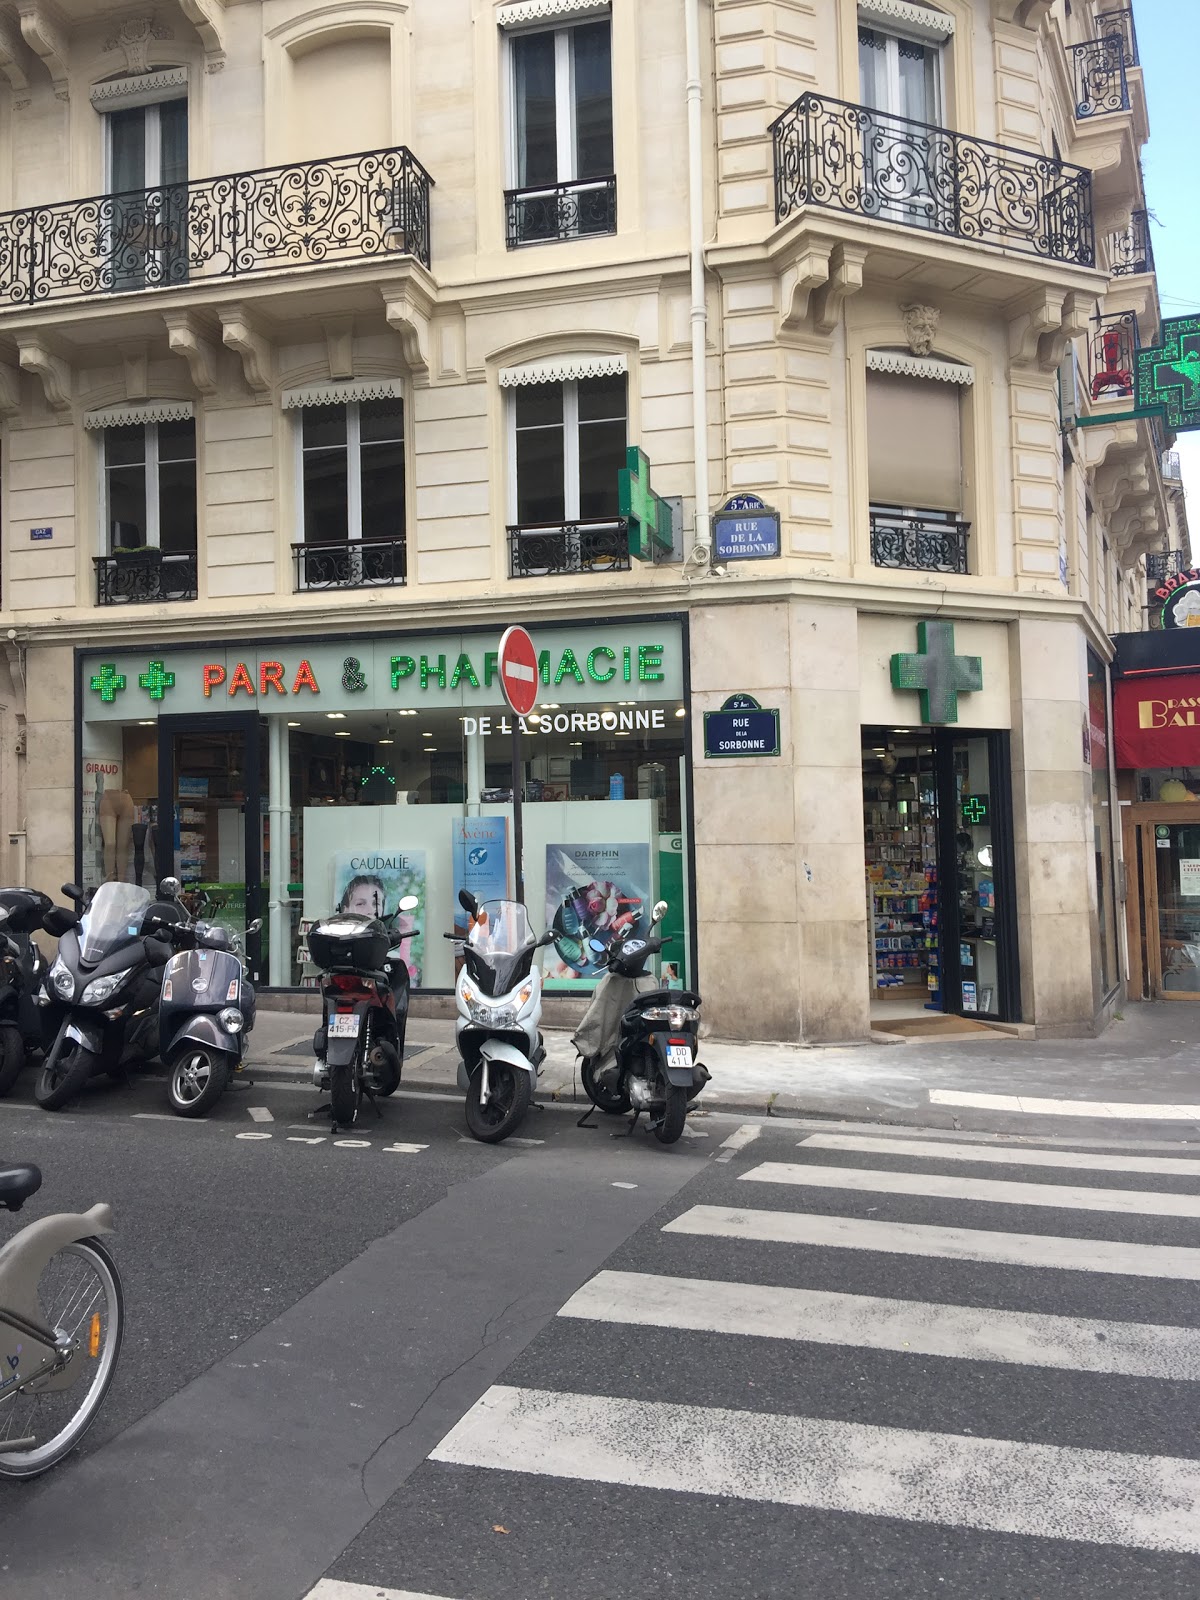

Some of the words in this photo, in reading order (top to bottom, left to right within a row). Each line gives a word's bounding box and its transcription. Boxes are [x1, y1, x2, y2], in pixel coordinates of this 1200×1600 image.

[735, 522, 757, 532] RUE
[730, 534, 745, 543] DE
[749, 533, 762, 542] LA
[719, 543, 775, 554] SORBONNE
[203, 659, 320, 698] PARA
[341, 656, 368, 692] &
[463, 717, 492, 736] DE
[540, 709, 666, 735] SORBONNE
[732, 718, 750, 727] RUE
[719, 740, 765, 750] SORBONNE
[85, 762, 119, 775] GIBAUD
